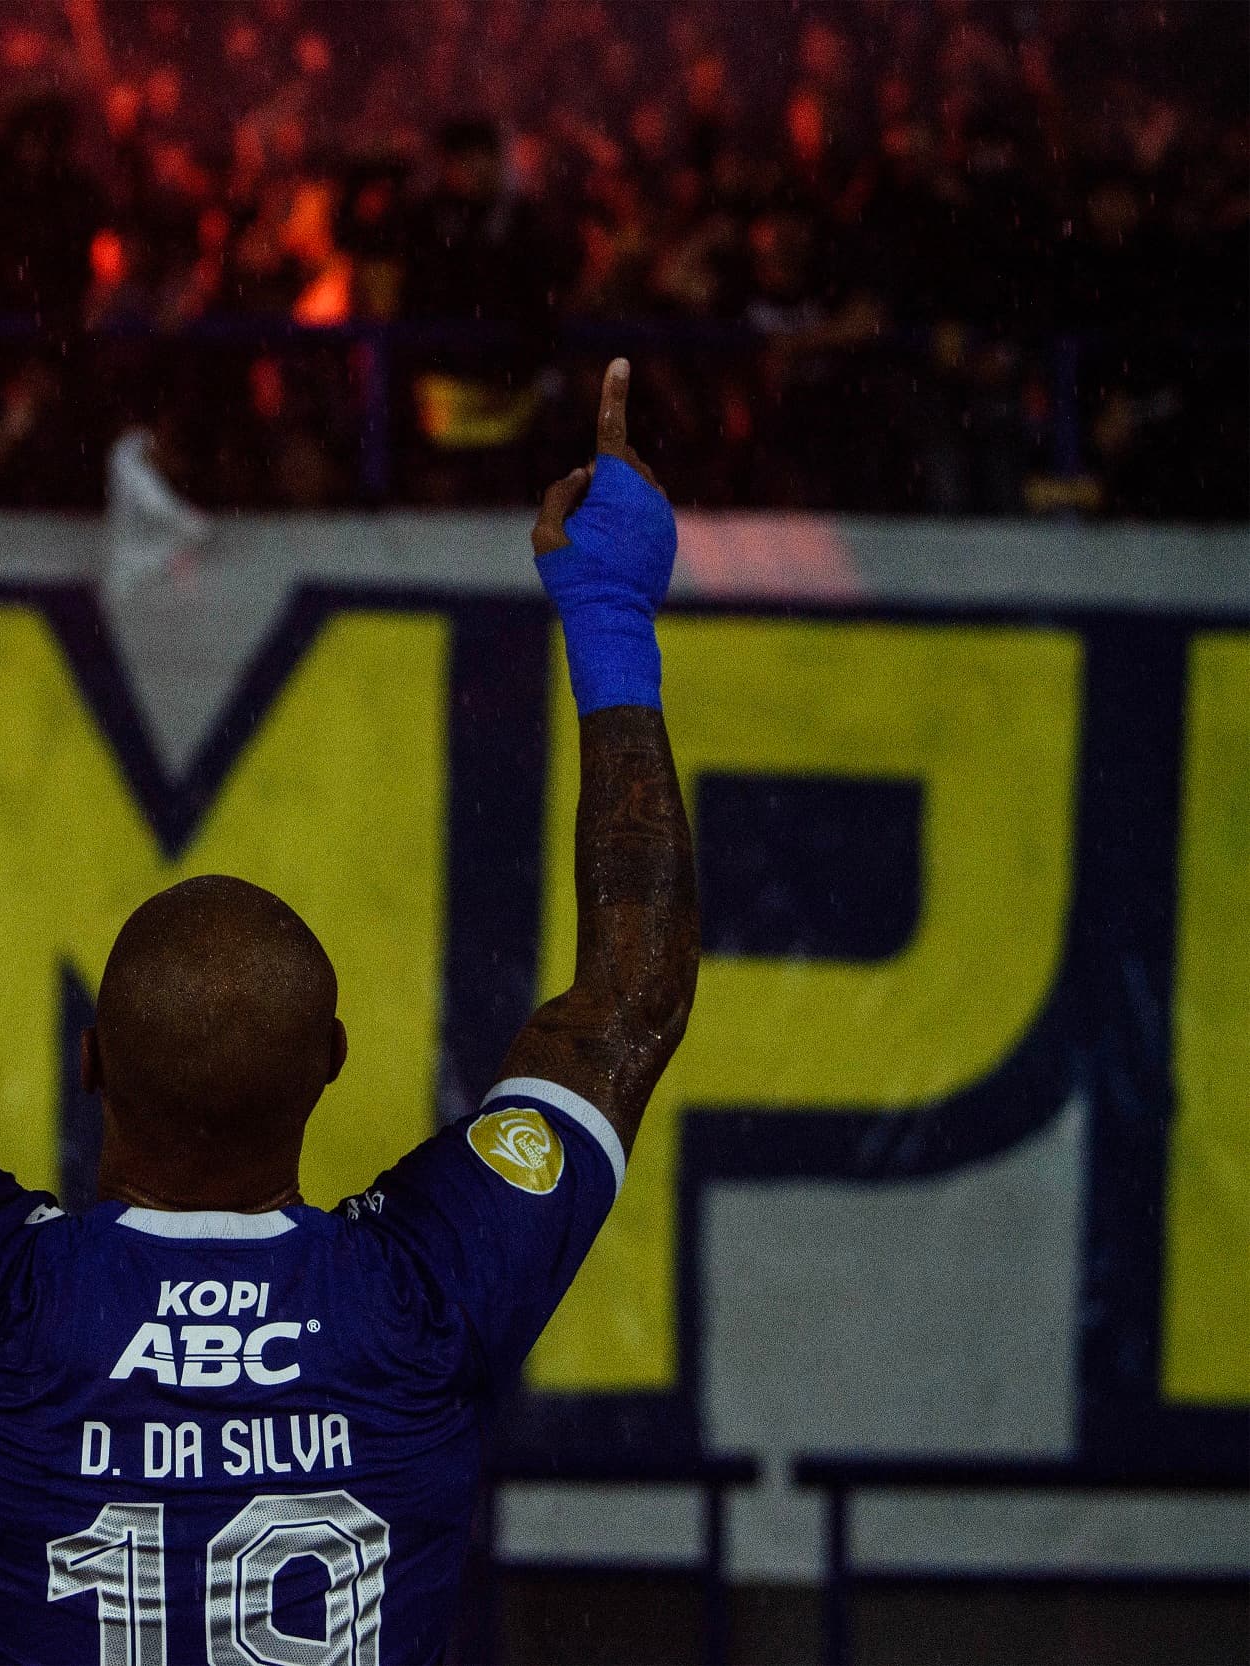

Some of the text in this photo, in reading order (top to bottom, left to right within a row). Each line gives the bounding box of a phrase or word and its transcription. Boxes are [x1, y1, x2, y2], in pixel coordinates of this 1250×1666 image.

[156, 1281, 269, 1317] KOPI
[80, 1414, 352, 1478] D. DA SILVA
[46, 1489, 390, 1666] 19
